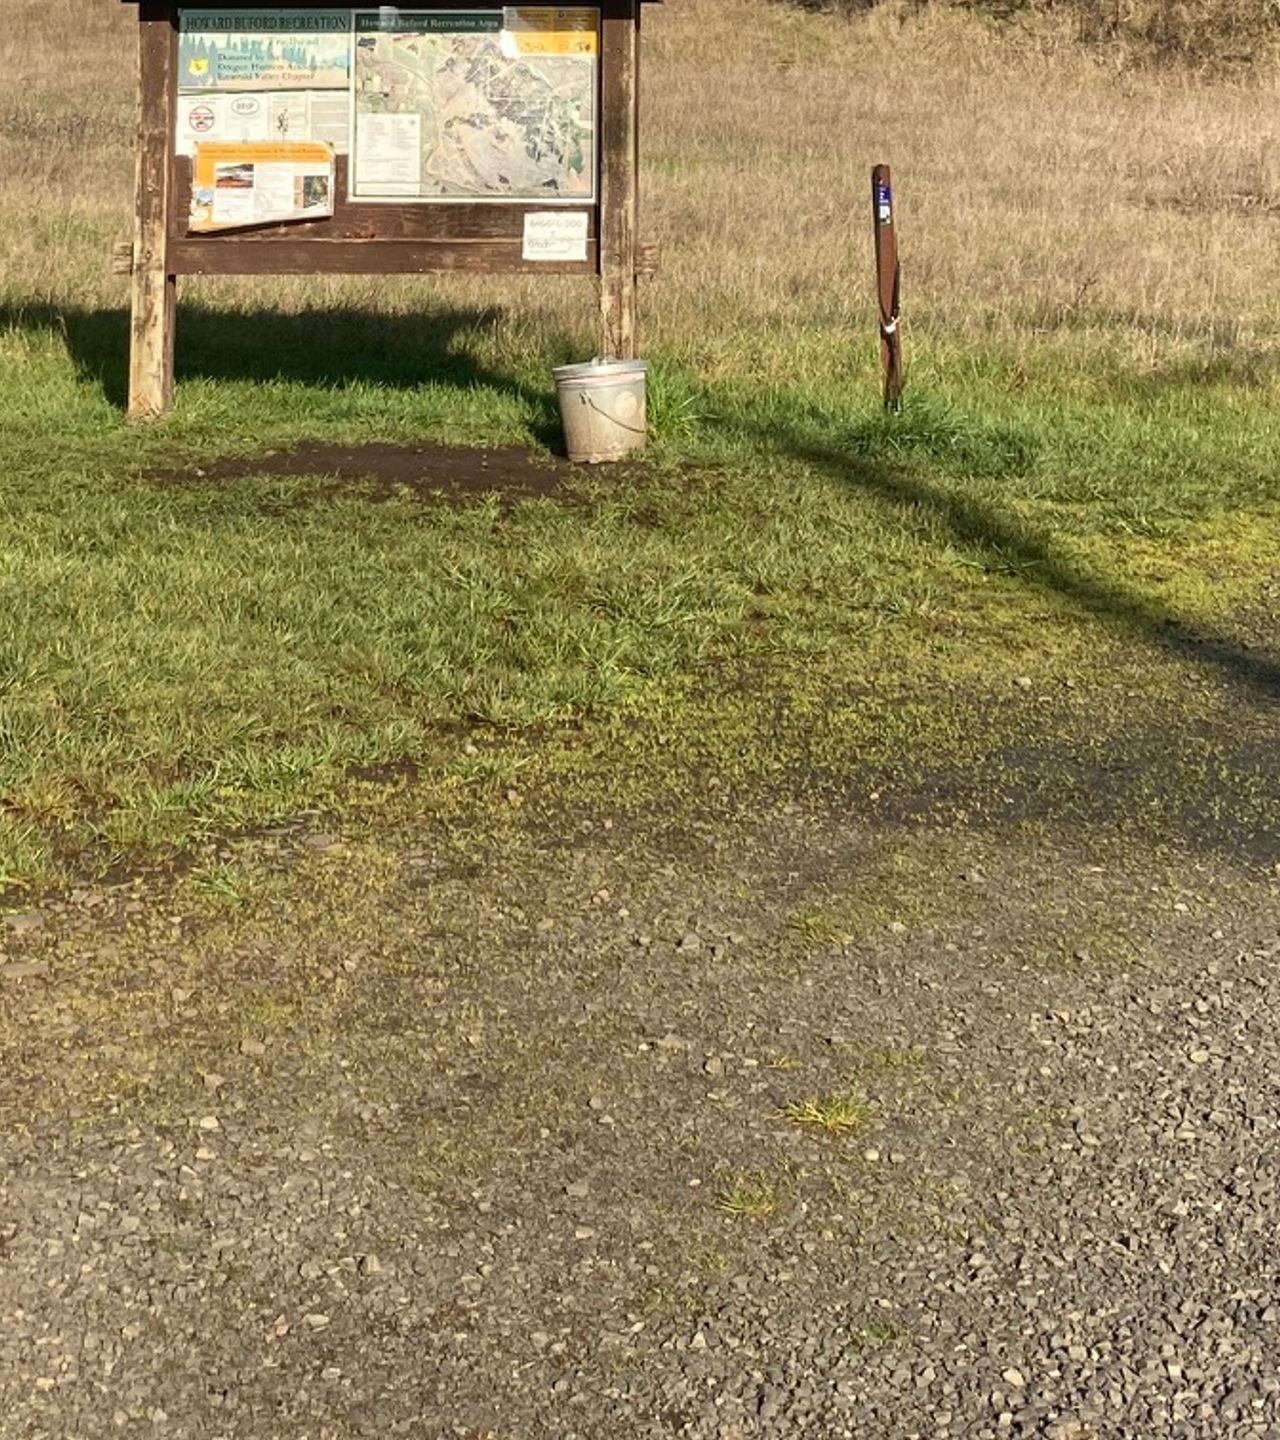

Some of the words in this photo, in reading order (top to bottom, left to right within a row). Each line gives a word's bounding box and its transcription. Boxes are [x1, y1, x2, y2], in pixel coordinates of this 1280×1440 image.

[186, 16, 231, 30] HOWARD
[234, 16, 278, 30] BUFORD
[279, 16, 347, 30] RECREATION
[399, 18, 428, 28] Buford
[430, 18, 476, 28] Recreation
[479, 18, 499, 28] Area
